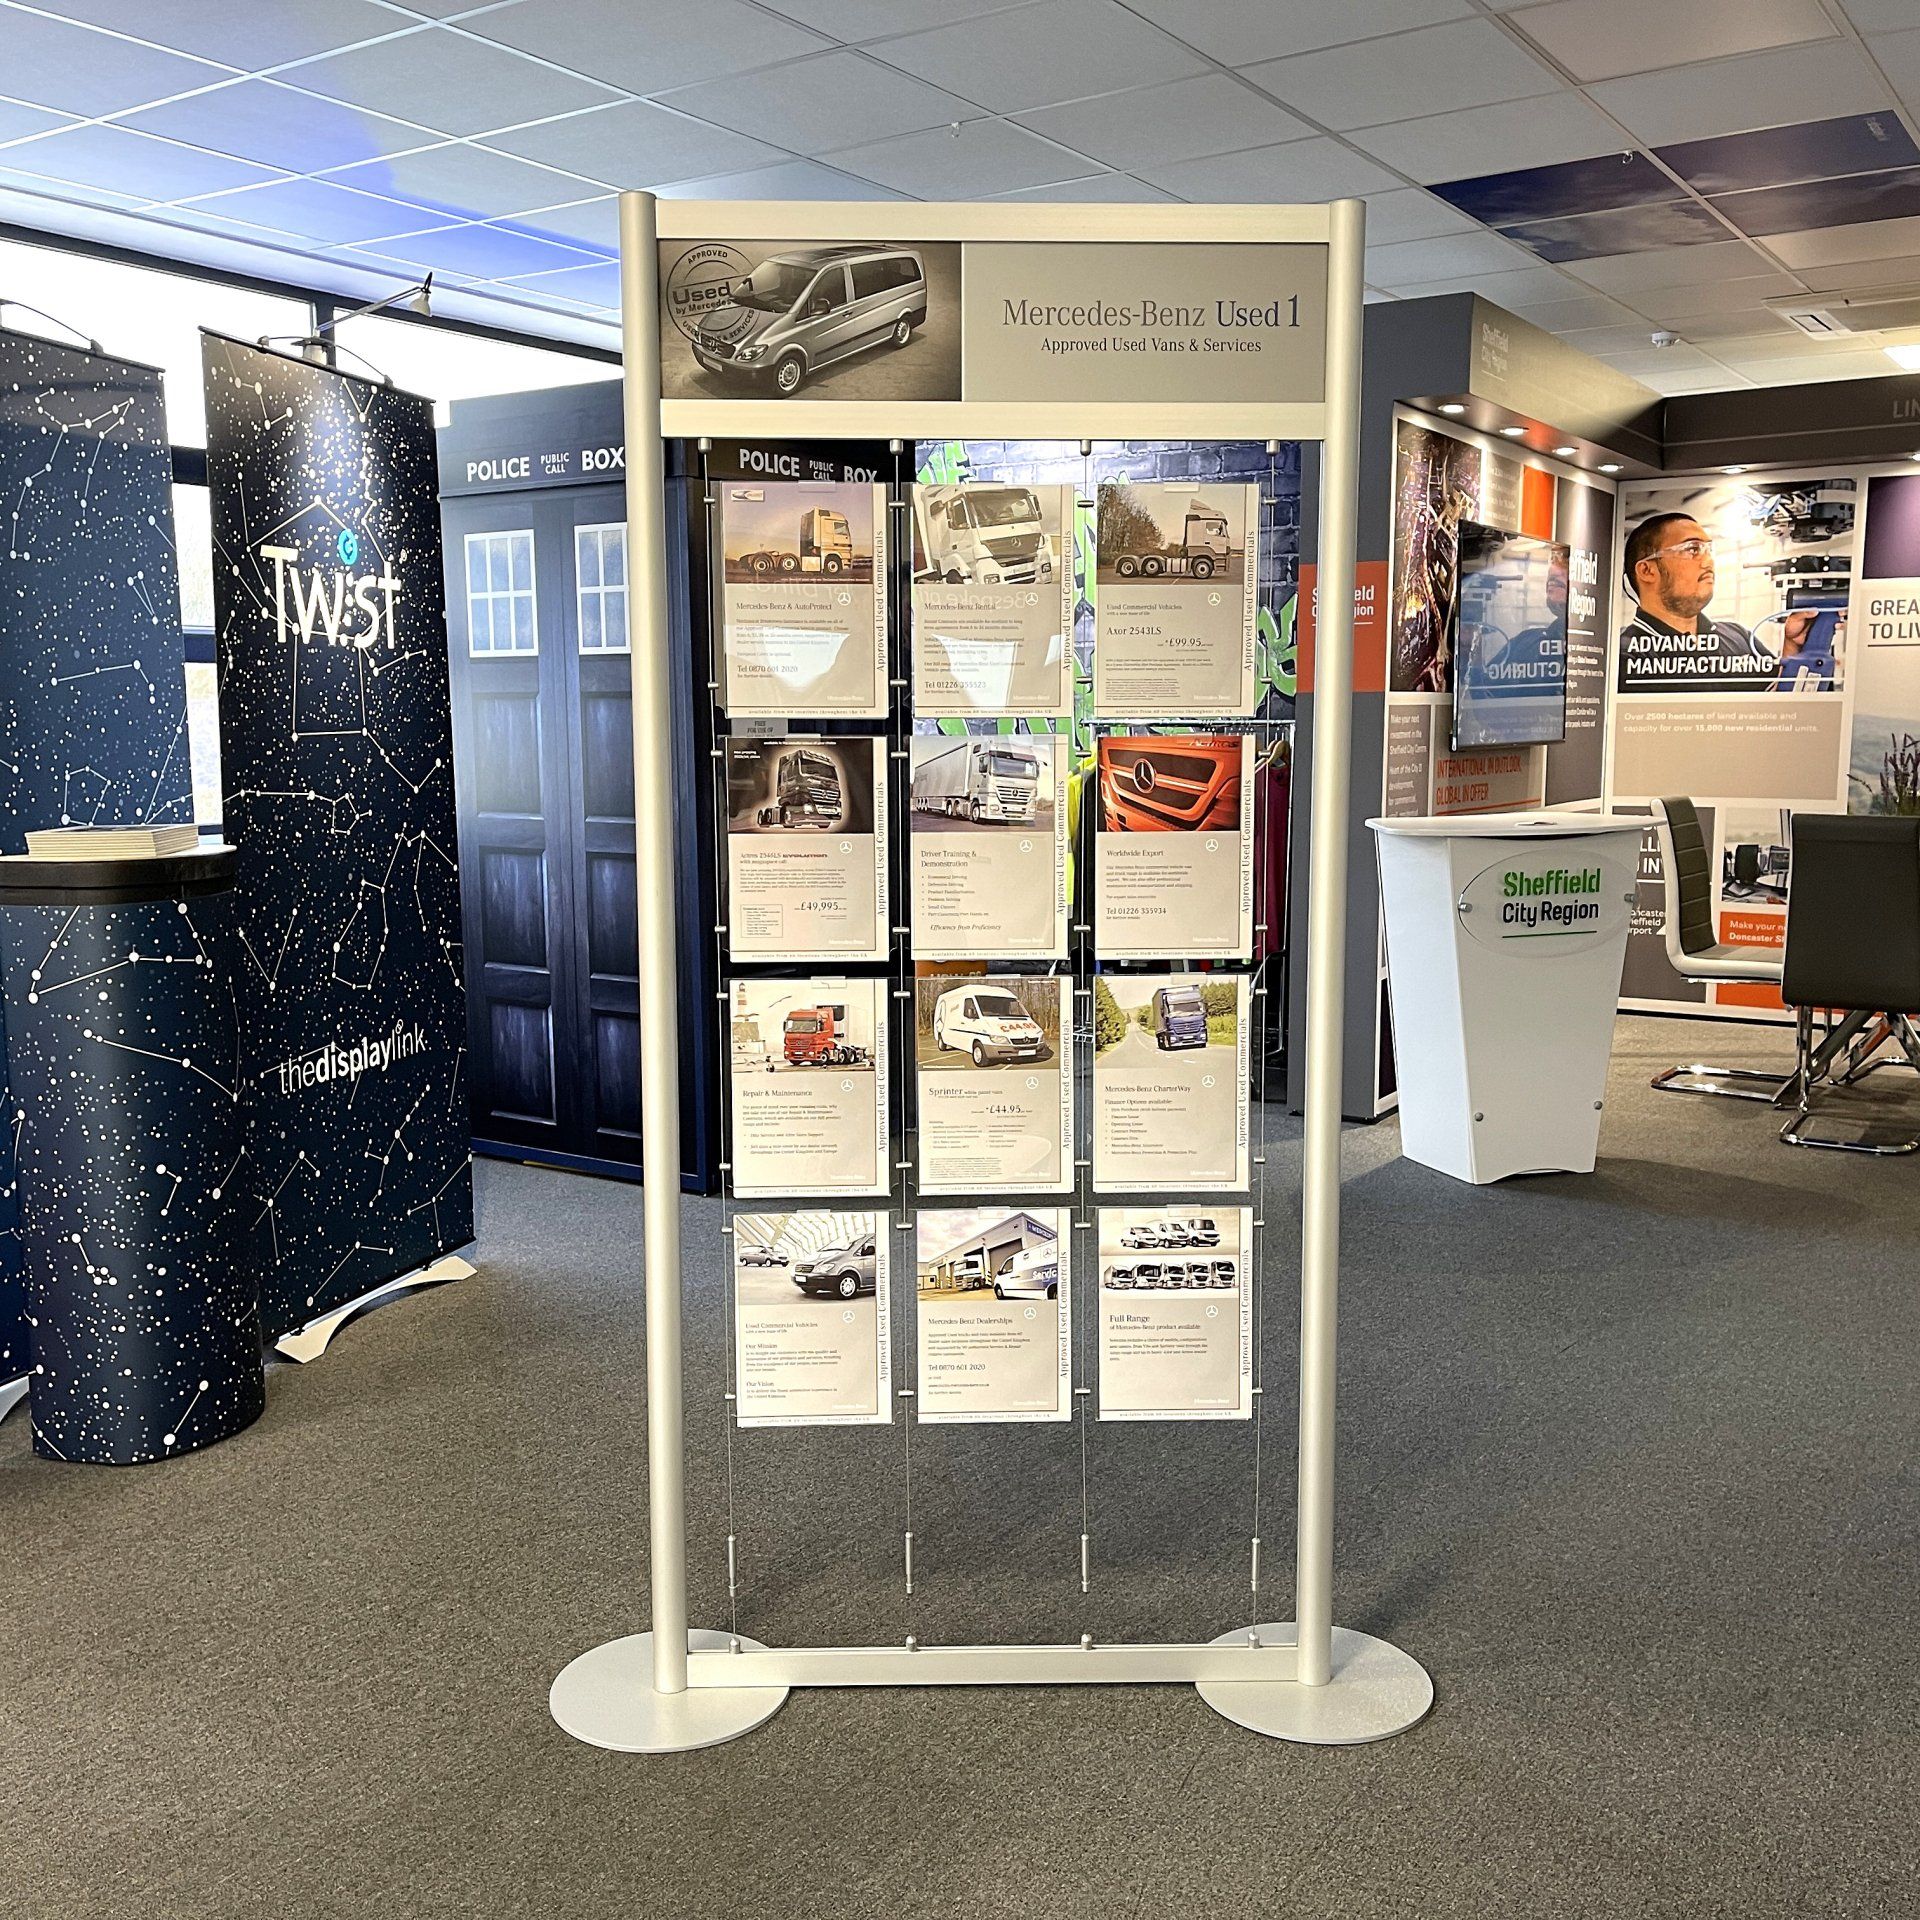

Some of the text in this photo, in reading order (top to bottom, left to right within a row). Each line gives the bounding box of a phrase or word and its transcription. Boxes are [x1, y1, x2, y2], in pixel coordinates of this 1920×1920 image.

[688, 250, 727, 264] APPROVED
[673, 281, 731, 304] Used
[676, 306, 686, 314] by
[1002, 294, 1300, 327] Mercedes-Benz Used 1
[1041, 338, 1262, 354] Approved Used Vans & Services
[467, 447, 625, 482] POLICE BOX
[541, 452, 569, 464] PUBLIC
[545, 464, 565, 474] CALL
[739, 449, 877, 482] POLICE BOX
[809, 460, 834, 472] PUBLIC
[813, 470, 830, 480] CALL
[874, 530, 886, 672] Approved Used Commercials
[1062, 530, 1072, 670] Approved Used Commercials
[1244, 531, 1254, 672] Approved Used Commercials
[1107, 627, 1127, 635] Axor
[1869, 623, 1893, 639] TO
[1628, 634, 1720, 653] ADVANCED
[1627, 655, 1773, 674] MANUFACTURING
[1624, 713, 1644, 721] Over
[1668, 712, 1704, 720] hectares
[1717, 712, 1736, 720] land
[1738, 712, 1777, 720] available
[1779, 712, 1797, 720] and
[1624, 724, 1657, 733] capacity
[1660, 724, 1672, 732] for
[1438, 756, 1486, 778] INTERNATIONAL
[1436, 785, 1461, 805] GLOBAL
[1470, 783, 1488, 801] OFFER
[876, 782, 884, 843] Commercials
[1056, 780, 1066, 915] Approved Used Commercials
[1241, 780, 1251, 914] Approved Used Commercials
[877, 871, 886, 916] Approved
[1504, 868, 1600, 896] Sheffield
[801, 902, 838, 912] £49,995
[1503, 900, 1598, 927] City Region
[1729, 921, 1776, 931] Make your
[1729, 933, 1772, 942] Doncaster
[279, 1019, 425, 1094] thedisplaylink
[929, 1088, 962, 1096] Sprinter
[1062, 1081, 1070, 1104] Used
[1238, 1018, 1248, 1148] Approved Used Commercials
[878, 1109, 888, 1152] Approved
[1063, 1106, 1072, 1149] Approved
[1060, 1251, 1068, 1308] Commercials
[1241, 1250, 1249, 1307] Commercials
[878, 1254, 888, 1381] Approved Used Commercials
[1126, 1315, 1150, 1323] Range
[1060, 1337, 1070, 1379] Approved
[1241, 1335, 1251, 1376] Approved
